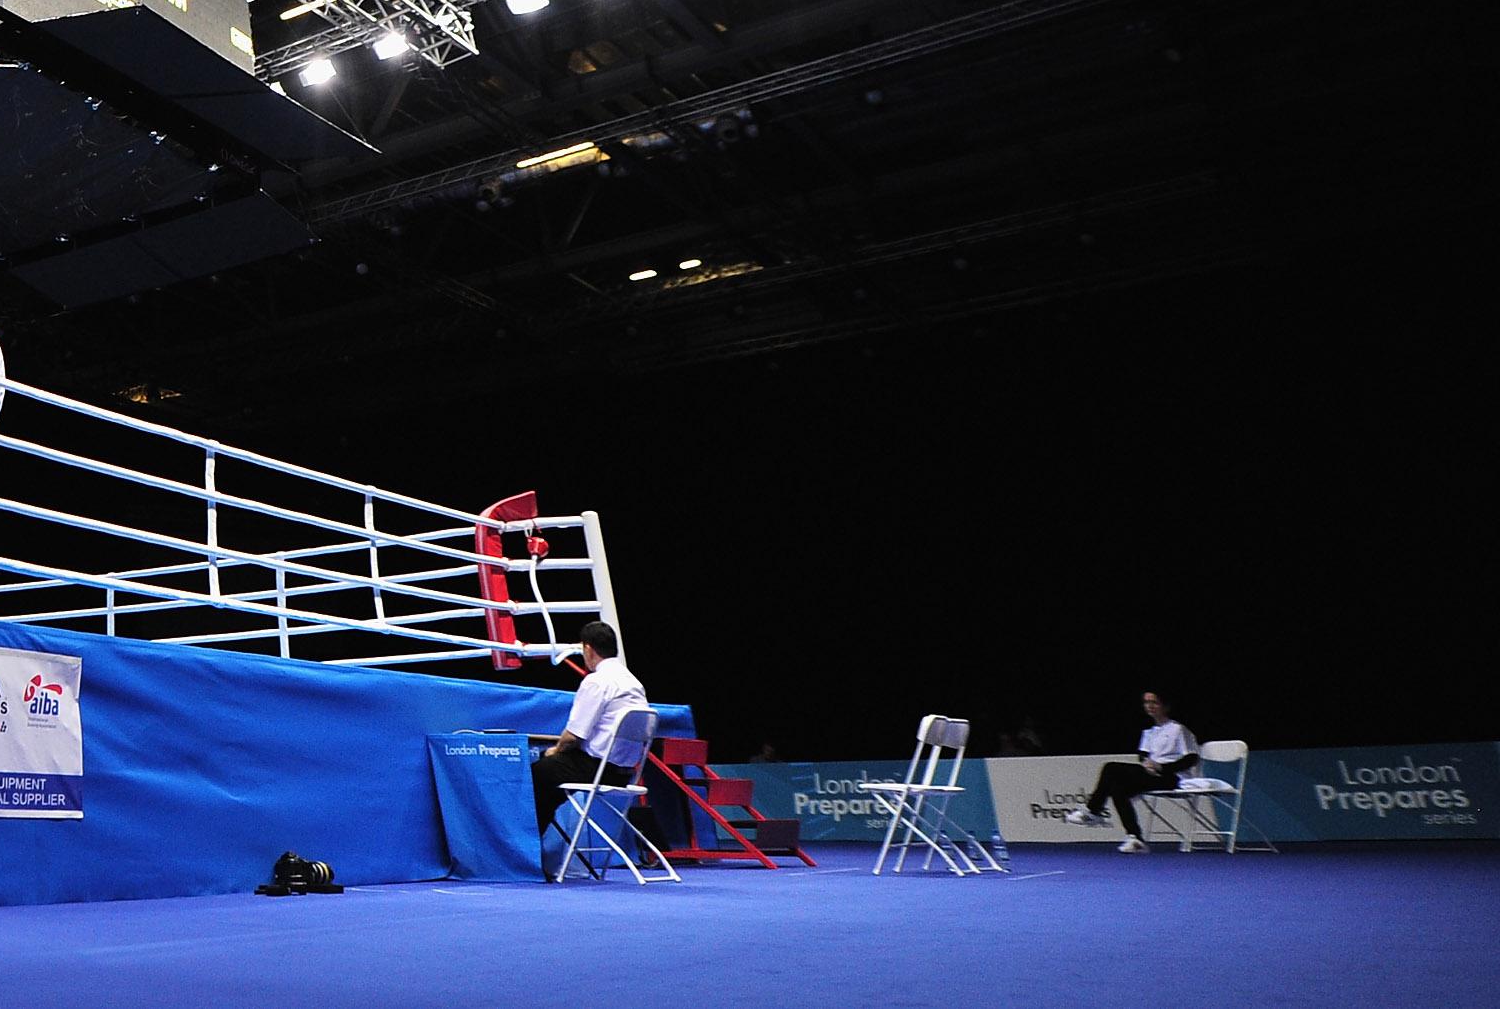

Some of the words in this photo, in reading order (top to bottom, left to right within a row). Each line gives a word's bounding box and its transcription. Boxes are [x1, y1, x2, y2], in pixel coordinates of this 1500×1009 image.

[30, 692, 59, 716] aiba
[445, 744, 477, 756] London
[479, 744, 520, 759] Prepares
[1338, 756, 1461, 785] London
[12, 793, 66, 806] SUPPLIER
[1315, 784, 1470, 818] Prepares
[1423, 811, 1478, 825] series
